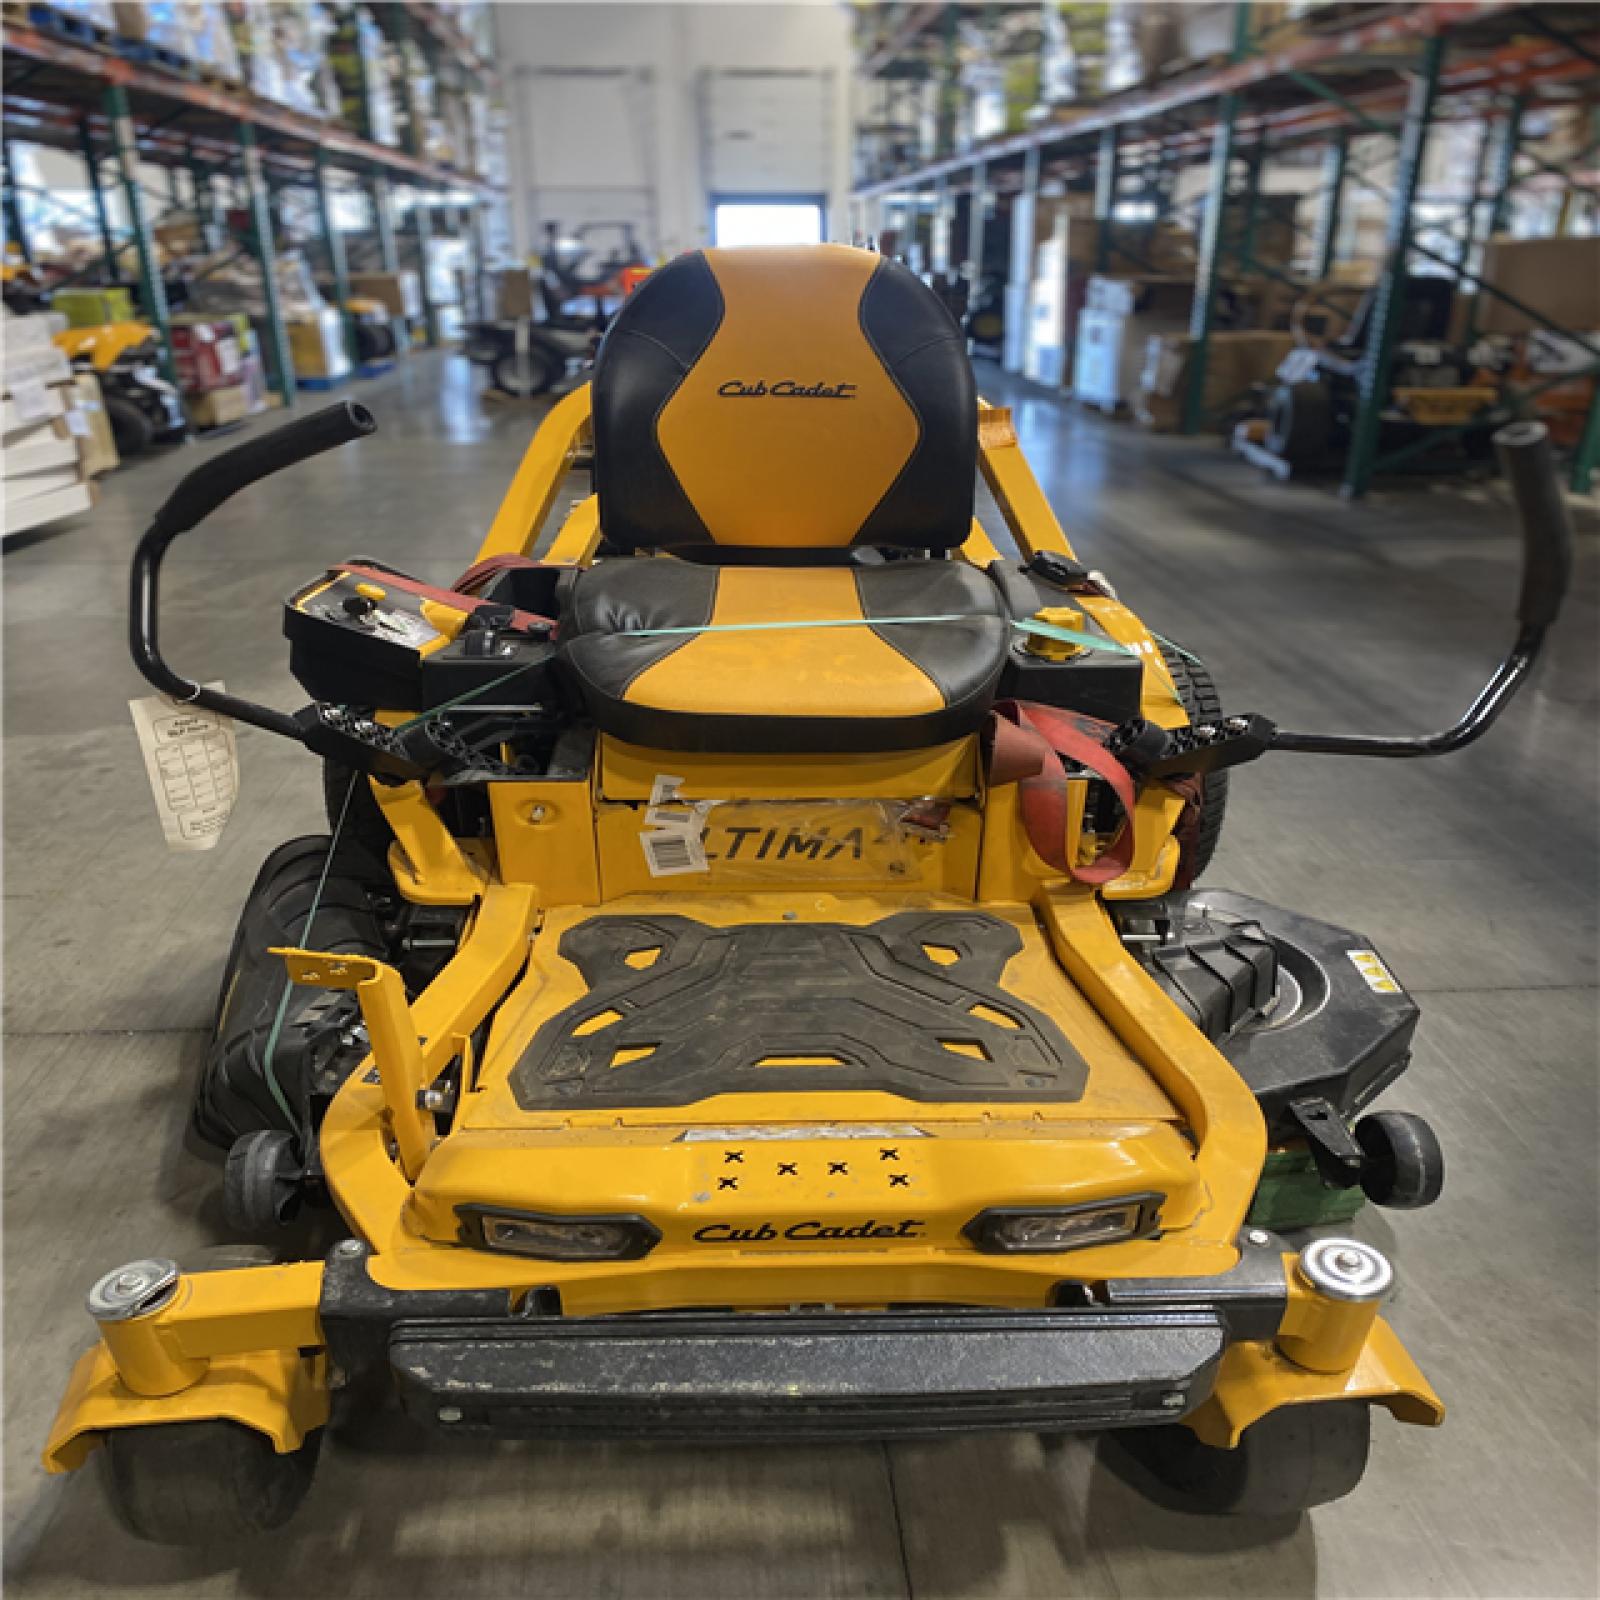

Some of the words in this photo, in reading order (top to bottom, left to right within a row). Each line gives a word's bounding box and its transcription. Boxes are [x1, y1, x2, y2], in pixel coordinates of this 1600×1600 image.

[718, 379, 767, 398] Cub
[770, 380, 857, 399] Cadet
[700, 826, 863, 860] LTIMA
[693, 1223, 777, 1242] Cub
[784, 1219, 925, 1240] Cadet
